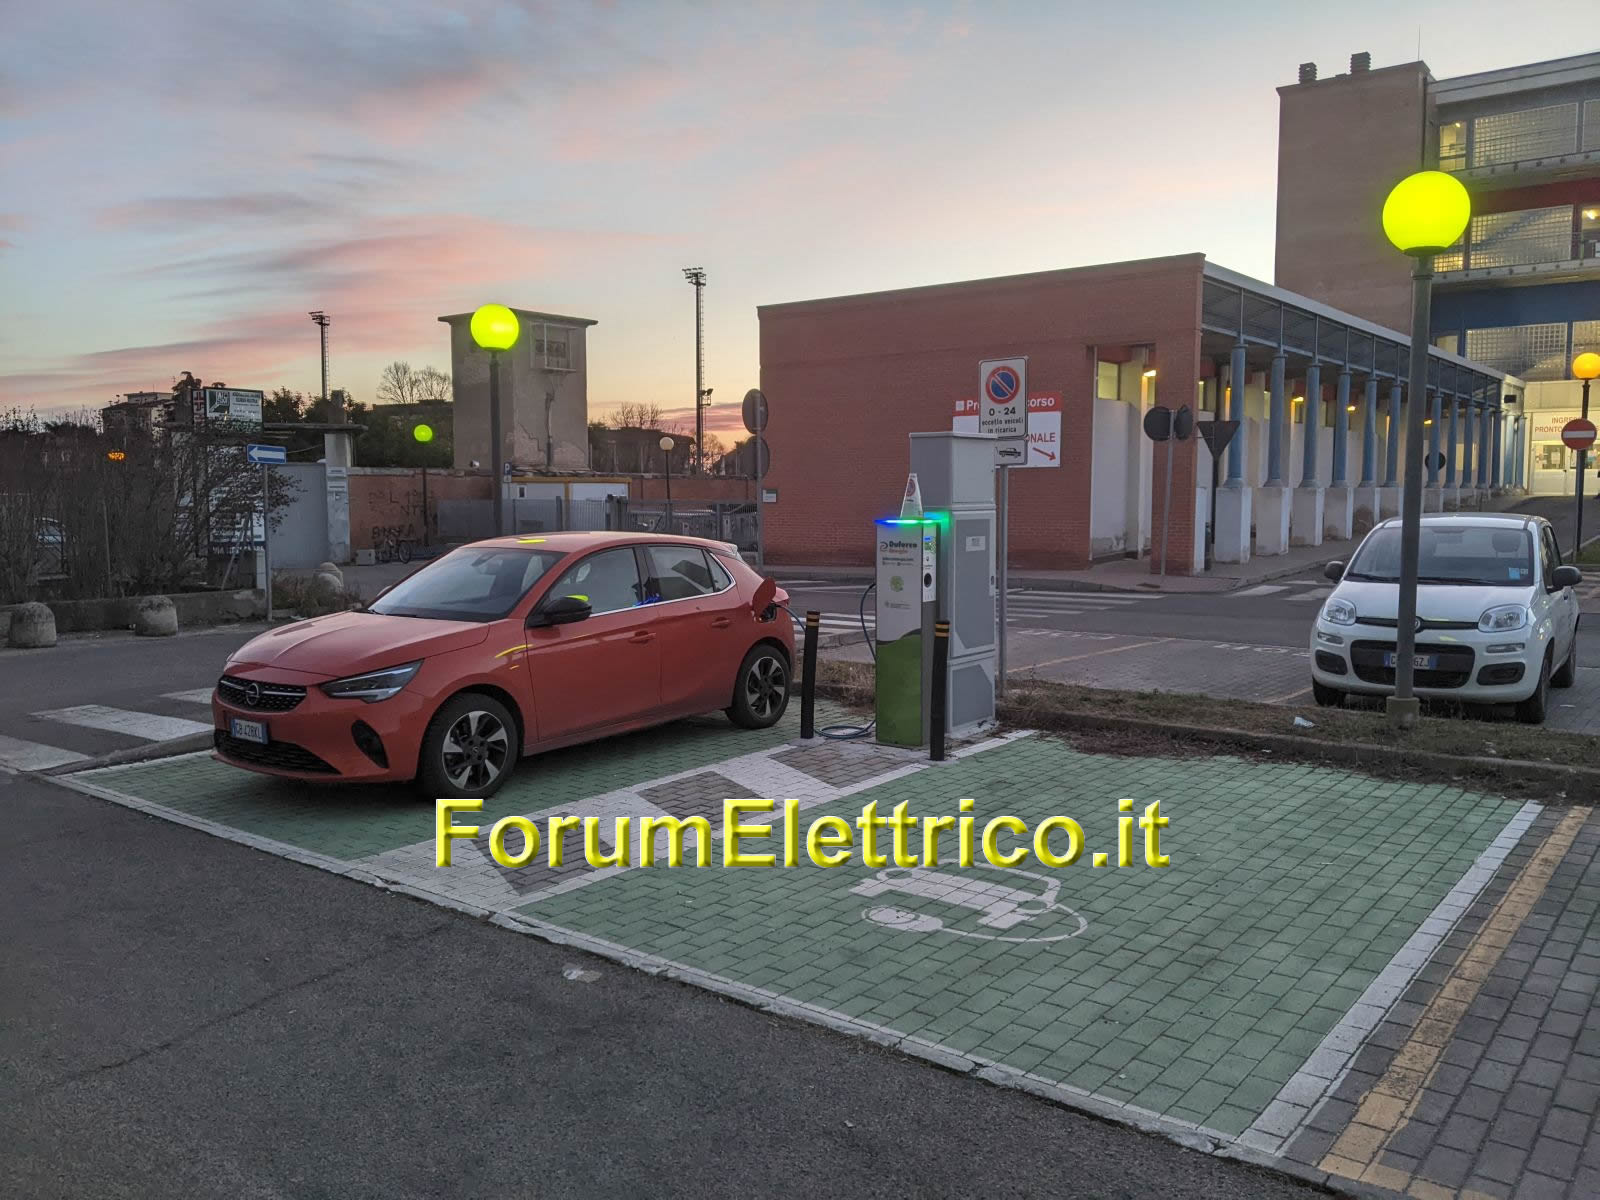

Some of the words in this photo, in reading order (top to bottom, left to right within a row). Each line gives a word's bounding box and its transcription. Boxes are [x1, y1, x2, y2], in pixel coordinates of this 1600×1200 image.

[988, 408, 995, 416] 0
[1003, 407, 1016, 415] 24
[1004, 416, 1024, 425] veicoli
